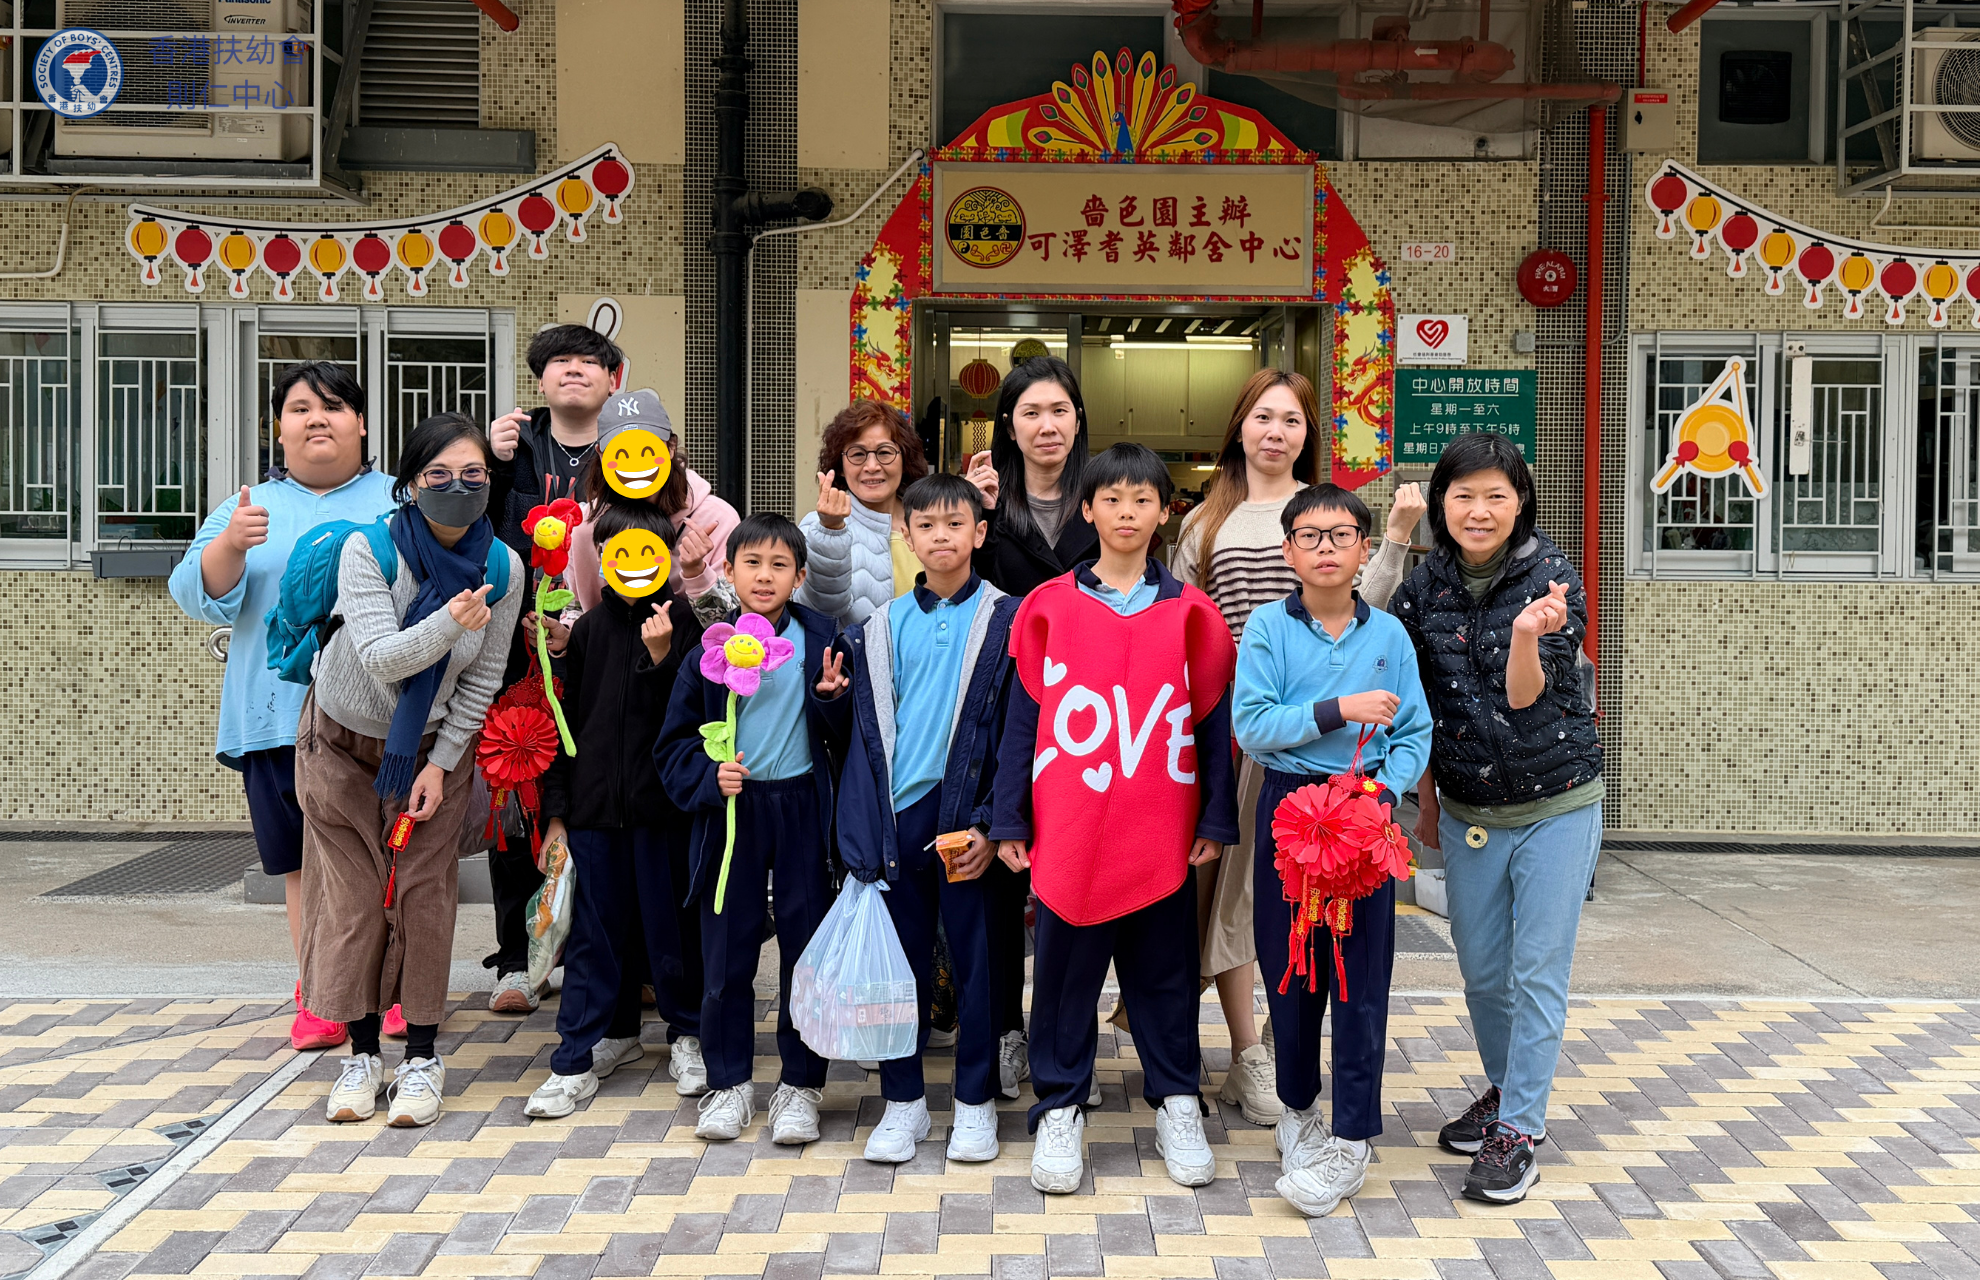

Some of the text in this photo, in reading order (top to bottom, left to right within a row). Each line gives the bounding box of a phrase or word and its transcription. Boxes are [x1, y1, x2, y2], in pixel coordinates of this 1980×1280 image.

[1027, 229, 1302, 264] 可澤耆英鄰舍中心
[1406, 245, 1449, 259] 16-20
[1546, 261, 1566, 279] ALARM
[1412, 377, 1519, 393] 中心開放時間
[1430, 403, 1500, 415] 星期一至六
[1409, 422, 1520, 435] 上午9時至下午5時
